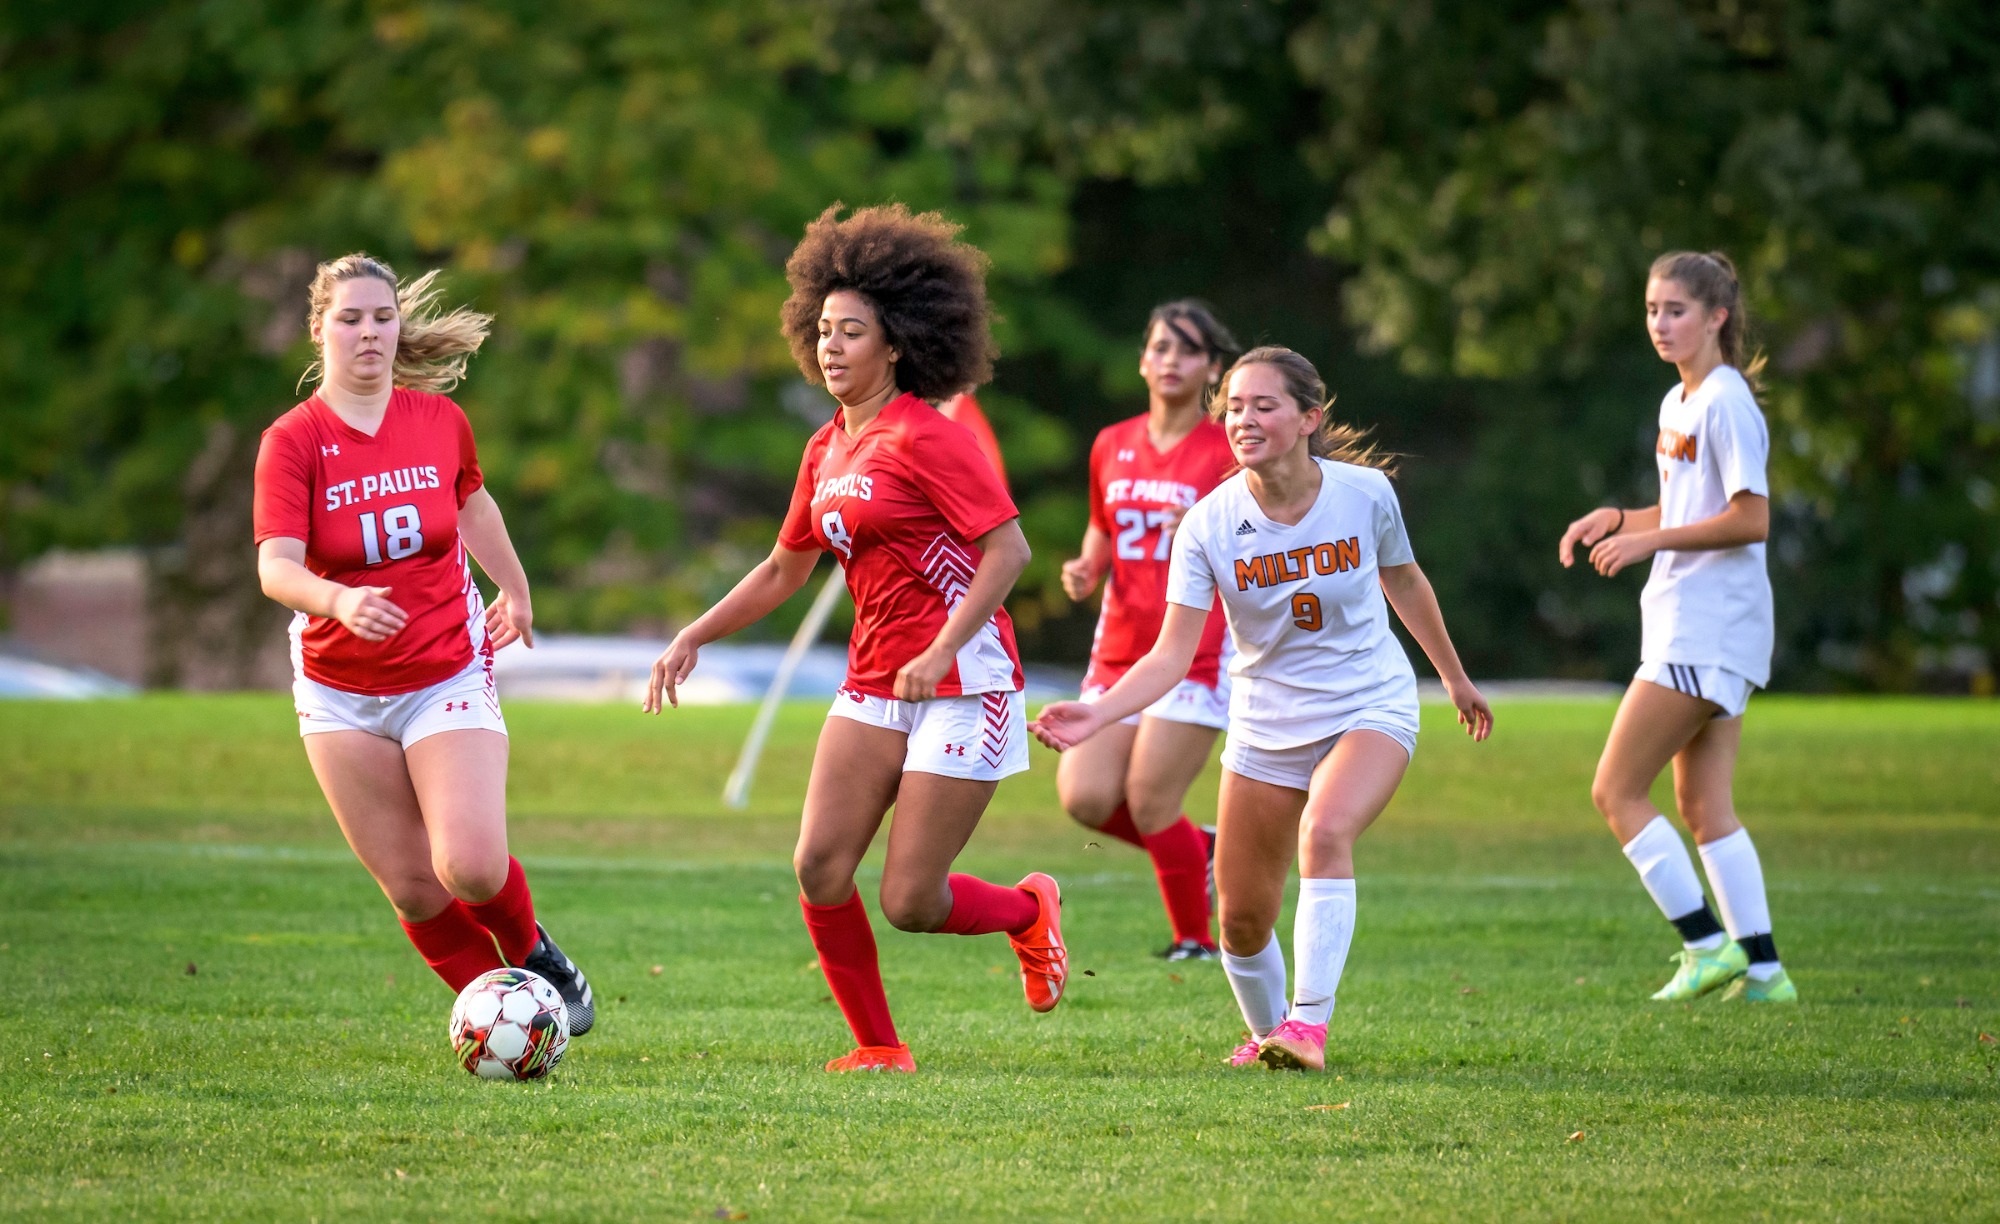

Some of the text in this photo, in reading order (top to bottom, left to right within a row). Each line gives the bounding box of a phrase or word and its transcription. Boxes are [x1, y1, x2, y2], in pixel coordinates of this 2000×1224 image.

[325, 465, 440, 512] ST. PAUL'S
[820, 473, 874, 502] PAUL'S
[1130, 479, 1198, 508] PAUL'S
[358, 503, 424, 566] 18
[821, 510, 853, 560] 8
[1115, 508, 1175, 562] 27
[1234, 536, 1361, 592] MILTON
[1291, 593, 1323, 632] 9
